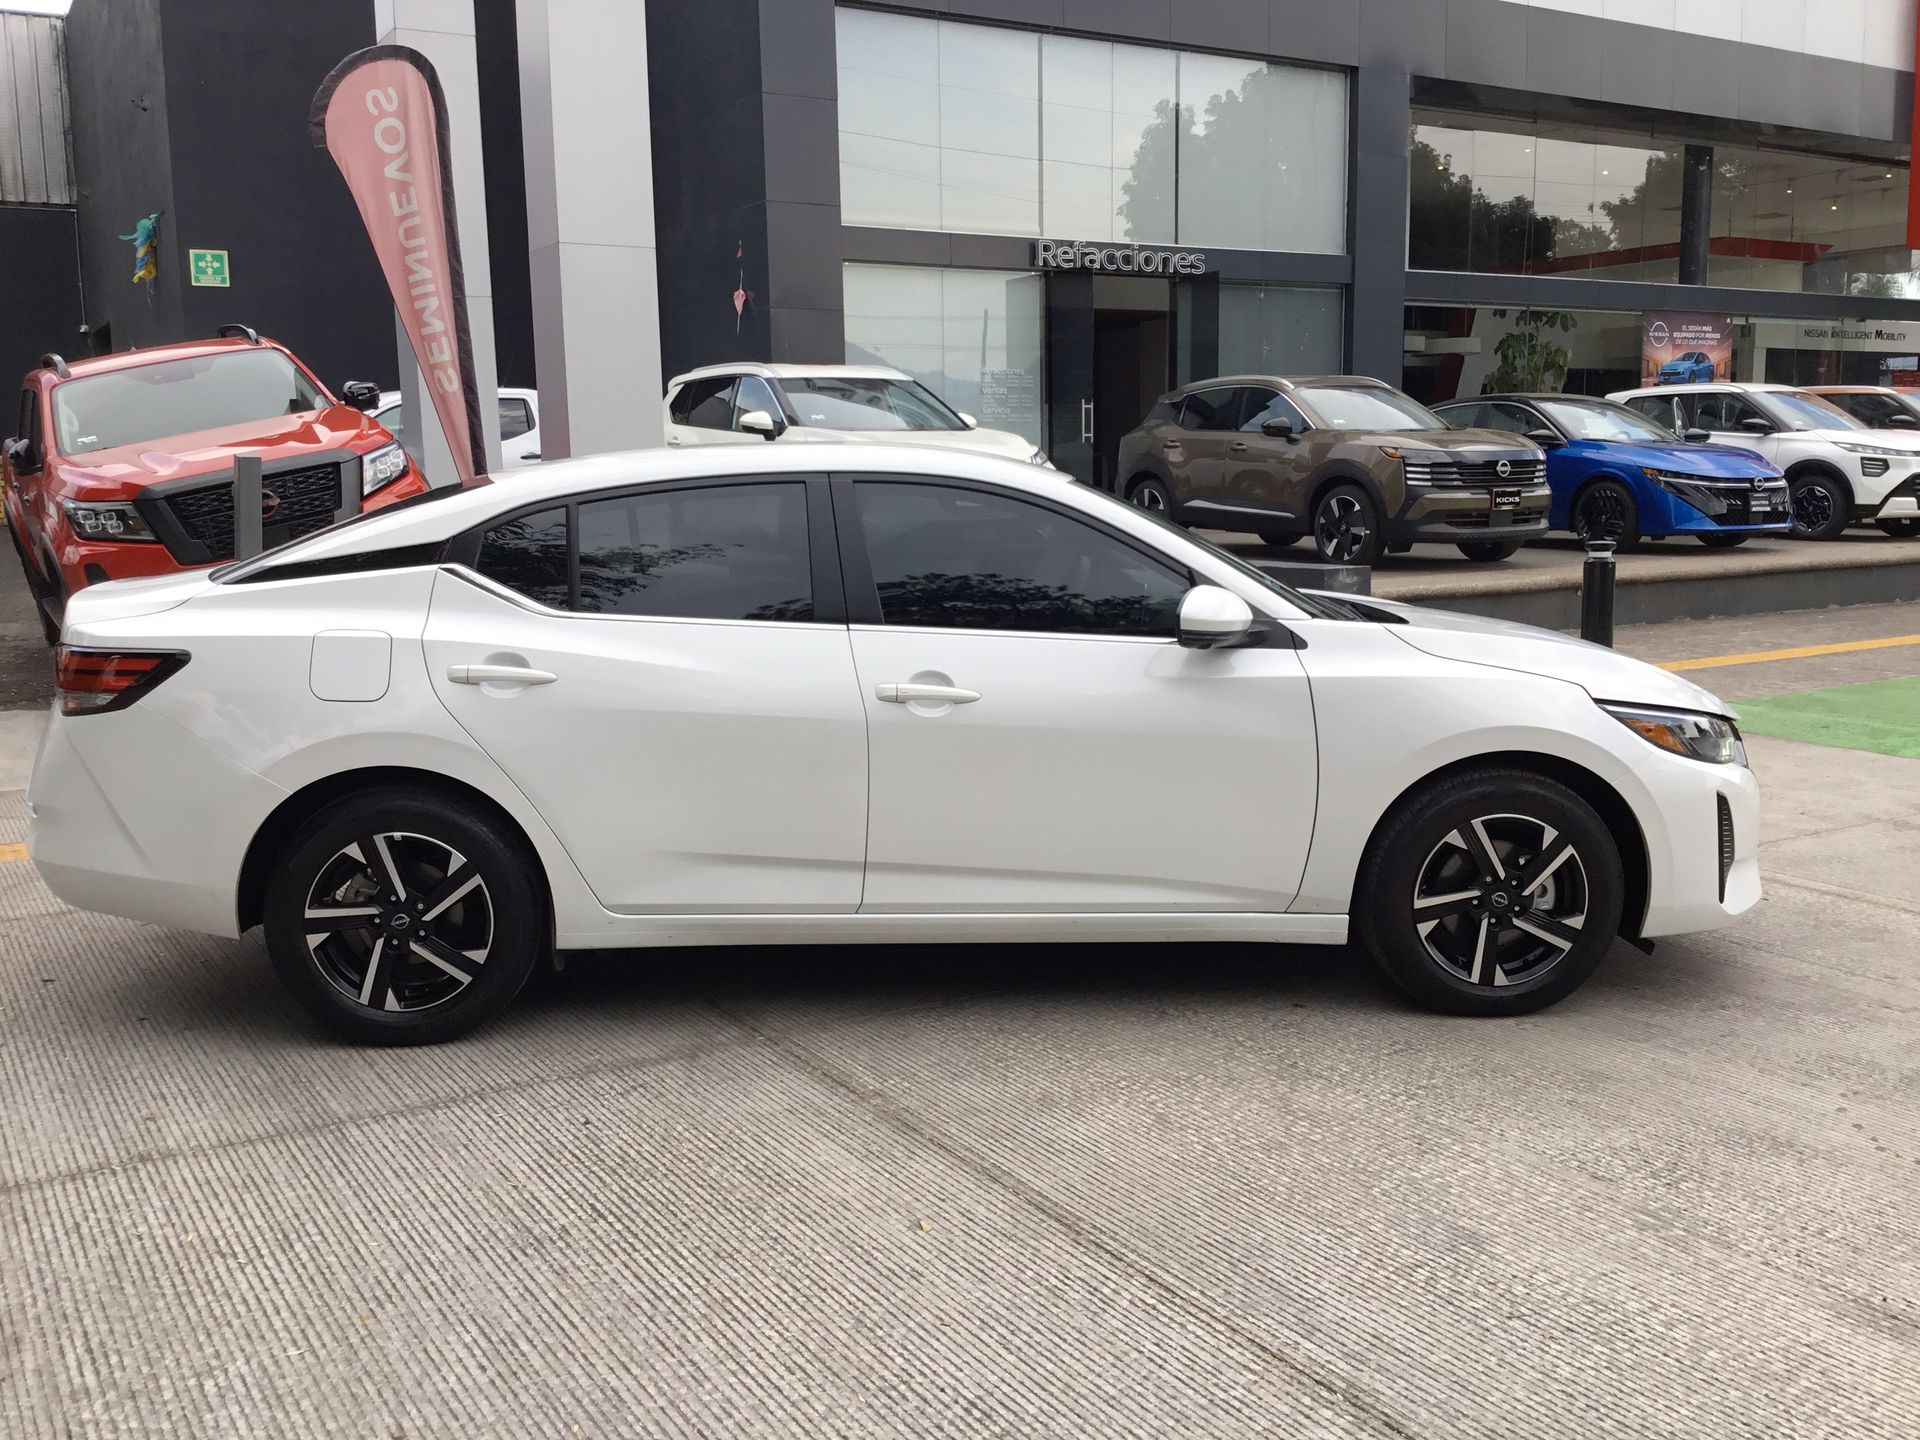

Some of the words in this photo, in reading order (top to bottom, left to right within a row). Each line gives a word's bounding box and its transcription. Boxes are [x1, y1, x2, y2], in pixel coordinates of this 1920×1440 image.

[1038, 239, 1206, 275] Refacciones
[1804, 329, 1829, 338] NISSAN
[1831, 328, 1874, 340] INTELLIGENT
[982, 406, 1011, 414] Servicio
